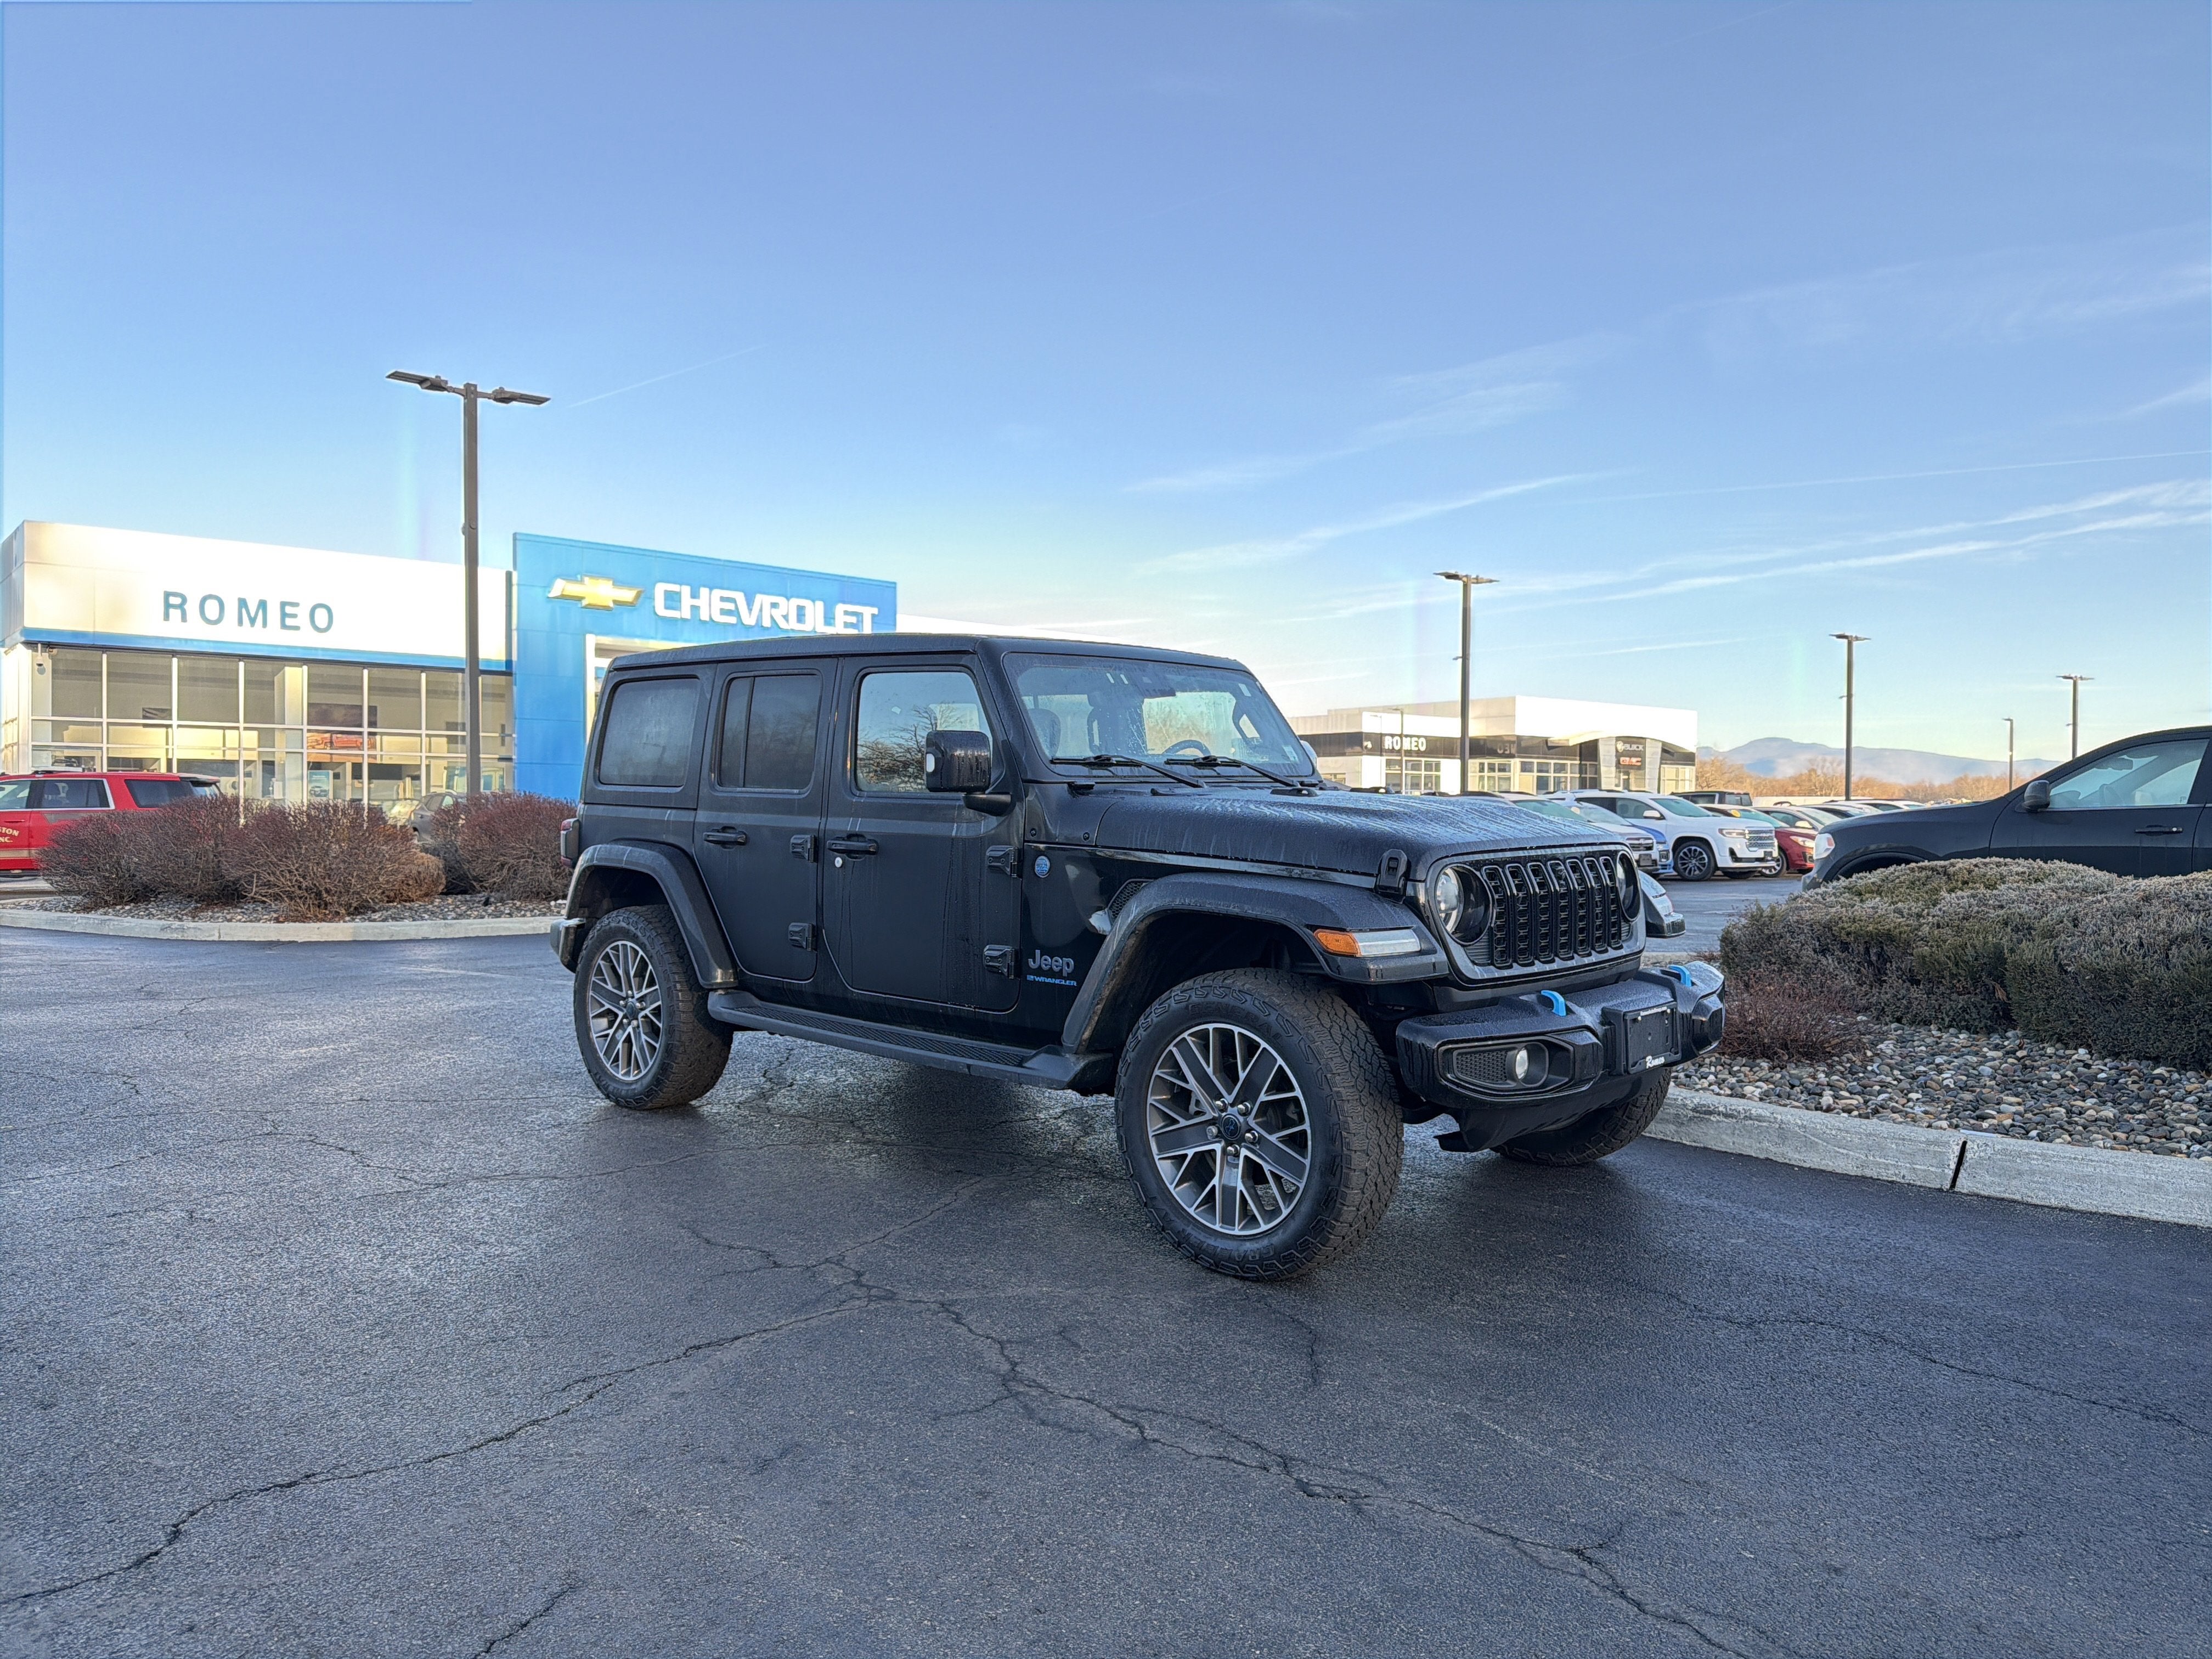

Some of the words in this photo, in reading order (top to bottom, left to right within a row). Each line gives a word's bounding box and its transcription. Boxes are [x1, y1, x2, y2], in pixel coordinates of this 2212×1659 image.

[163, 590, 334, 633] ROMEO
[654, 582, 878, 634] CHEVROLET
[1385, 736, 1426, 751] ROMEO
[1620, 757, 1641, 766] GMC
[0, 826, 20, 837] TON
[1028, 950, 1074, 977] Jeep
[1034, 976, 1077, 986] WRANGLER
